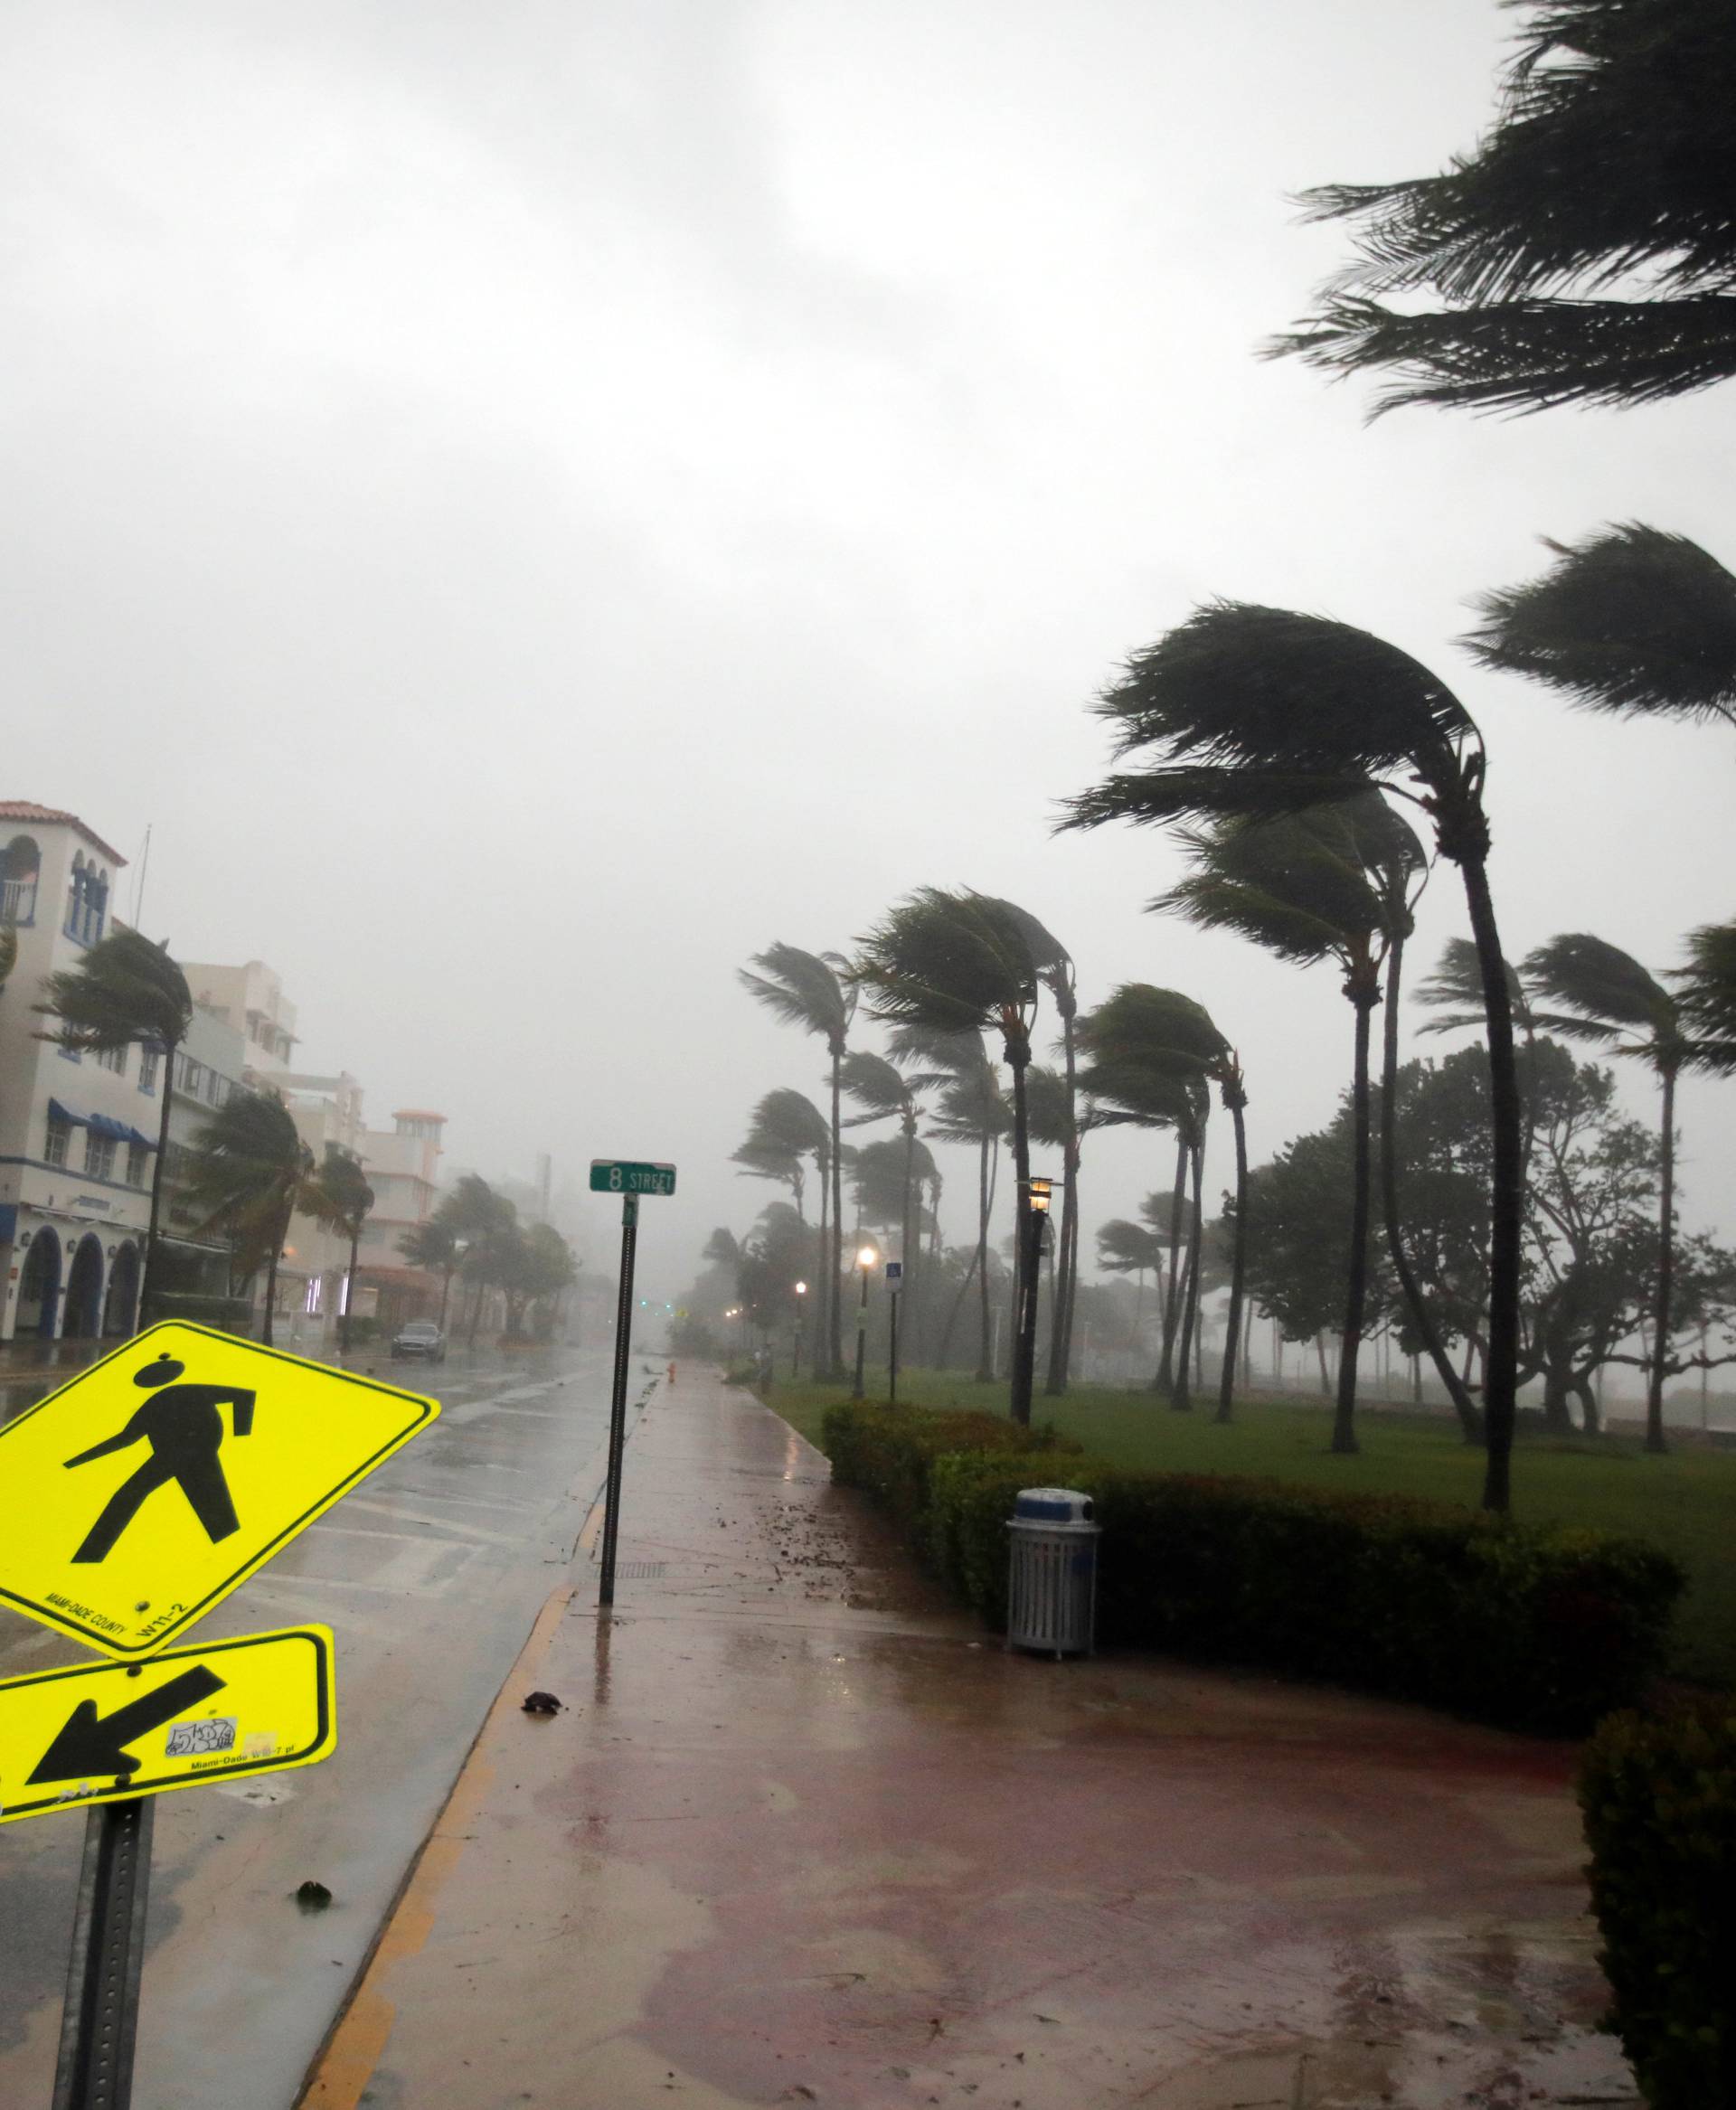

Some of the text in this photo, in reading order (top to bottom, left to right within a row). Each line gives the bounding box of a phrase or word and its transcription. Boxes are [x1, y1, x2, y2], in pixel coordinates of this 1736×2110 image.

[609, 1167, 673, 1191] 8 STREET
[45, 1593, 127, 1634] MIAMI-DADE COUNTY
[136, 1604, 188, 1636] W11-2
[191, 1755, 247, 1770] Miami-Dade
